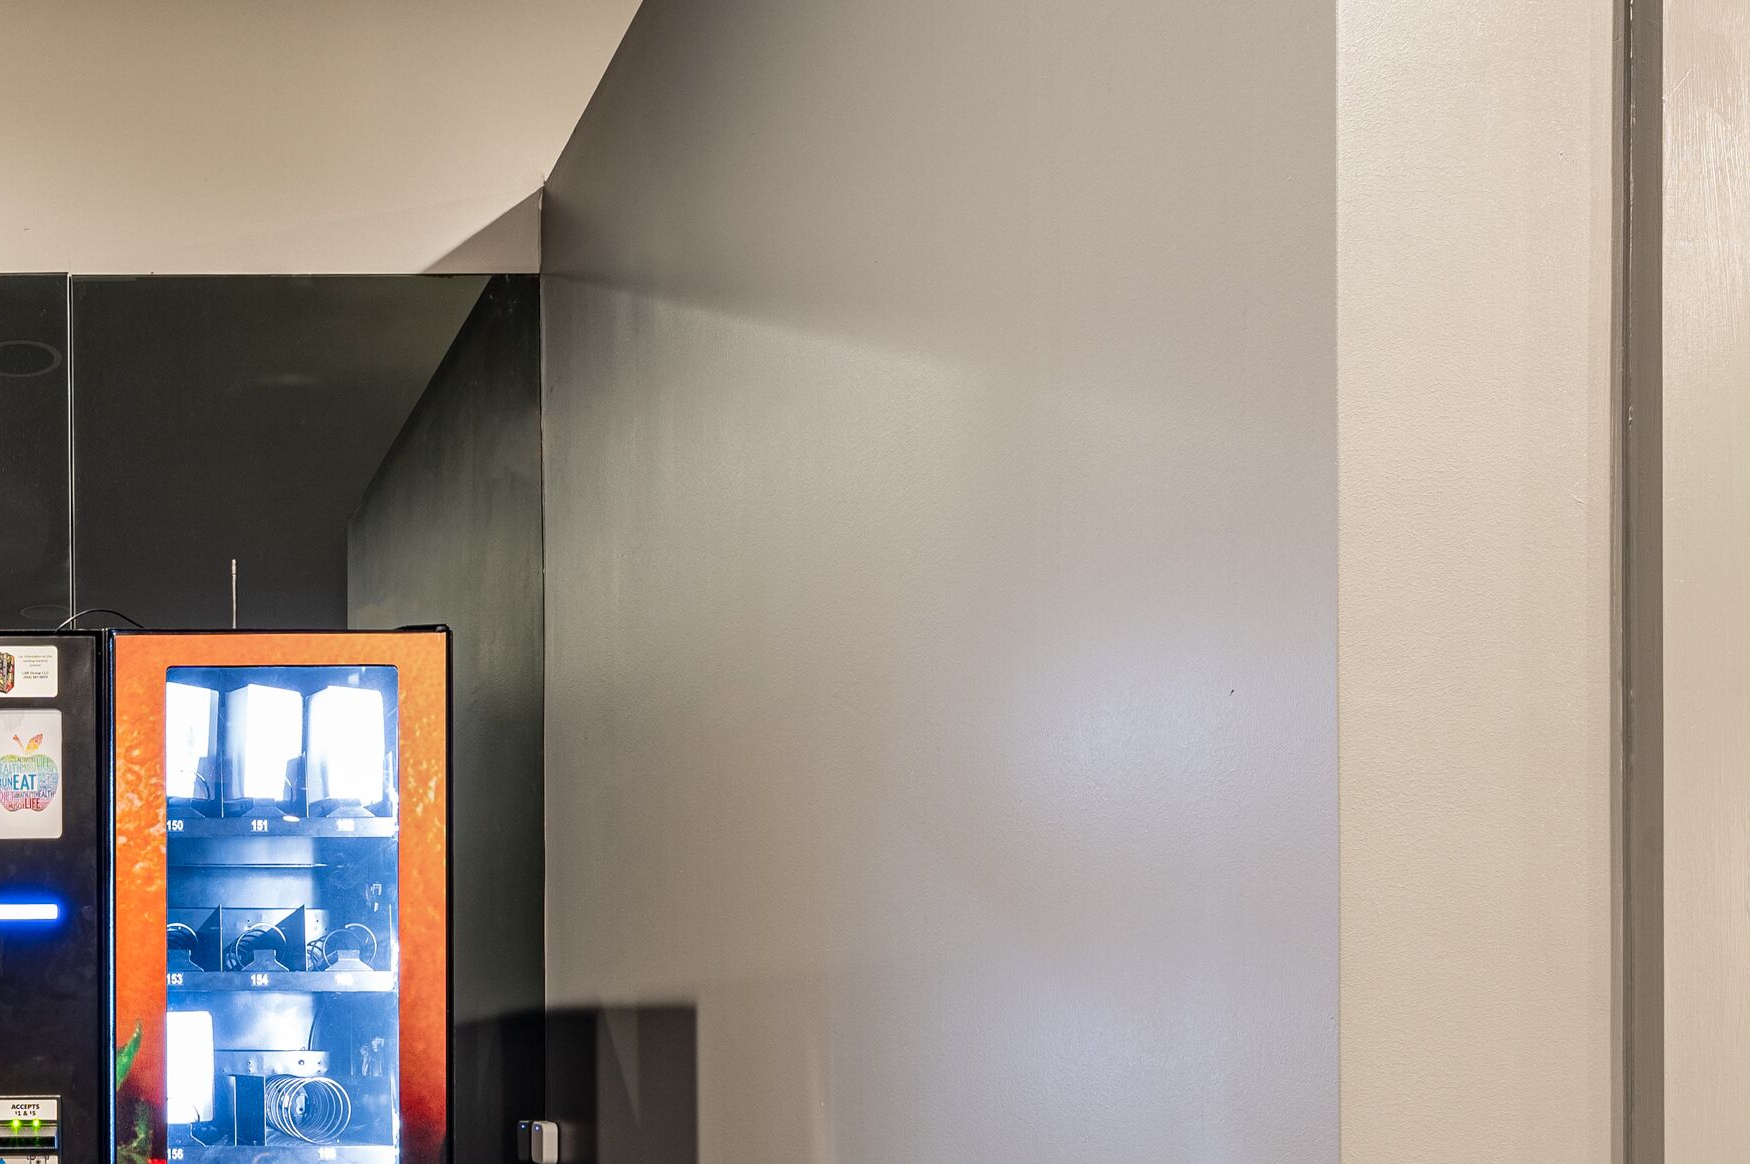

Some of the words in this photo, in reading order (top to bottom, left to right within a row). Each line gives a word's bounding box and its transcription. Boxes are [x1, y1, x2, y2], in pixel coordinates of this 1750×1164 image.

[13, 774, 36, 790] EAT
[25, 798, 40, 809] LIFE
[167, 819, 184, 831] 150
[251, 819, 268, 831] 151
[251, 974, 268, 986] 154
